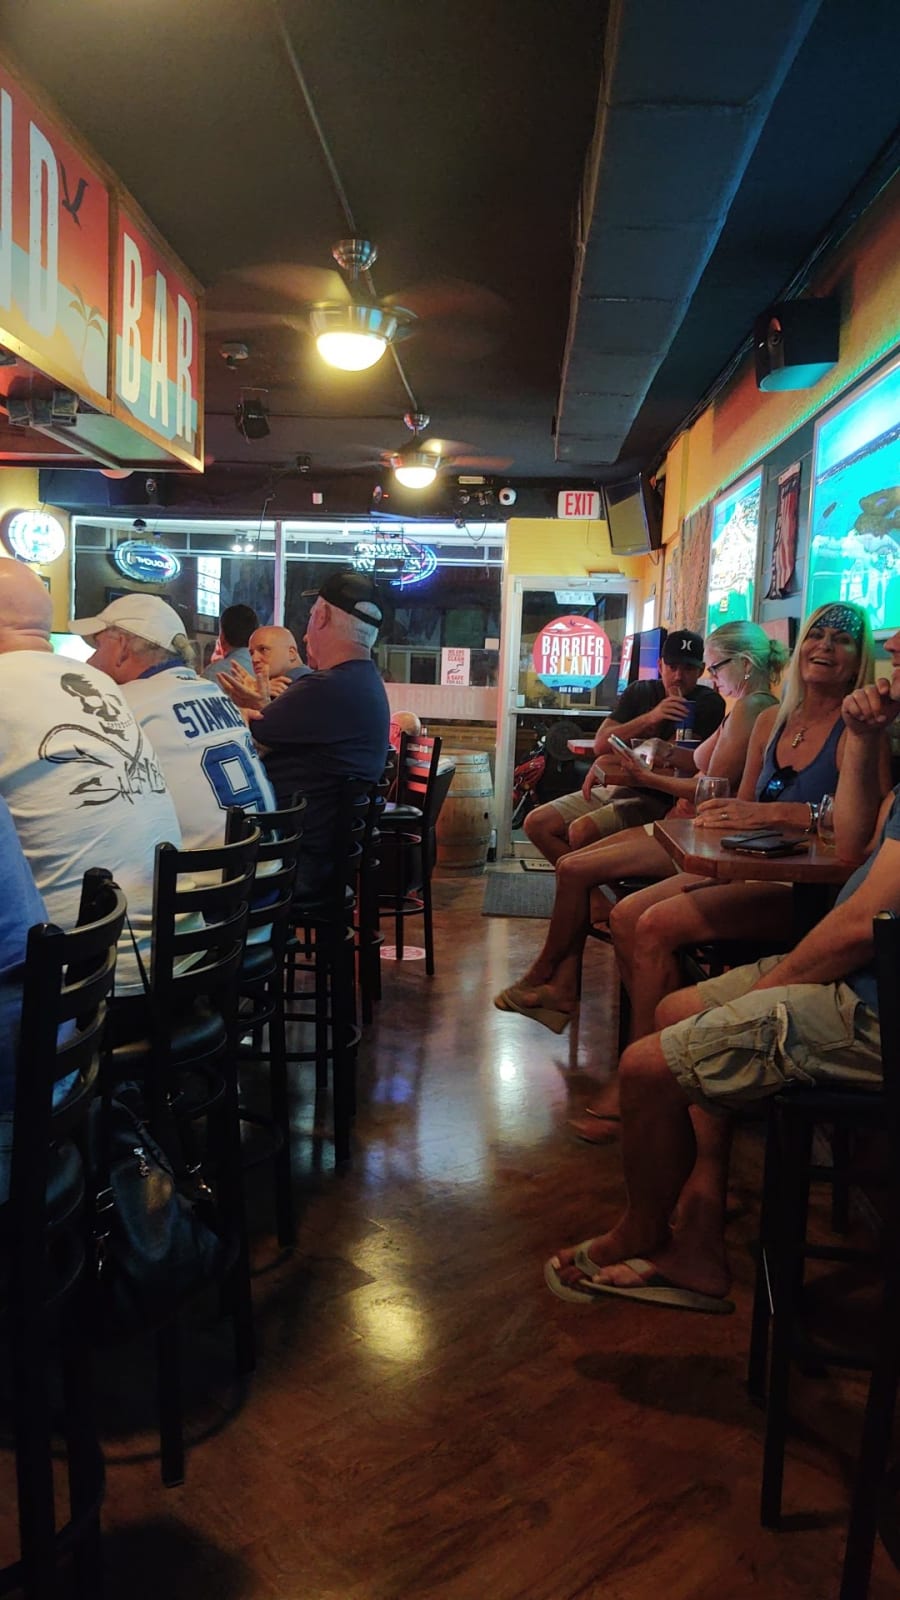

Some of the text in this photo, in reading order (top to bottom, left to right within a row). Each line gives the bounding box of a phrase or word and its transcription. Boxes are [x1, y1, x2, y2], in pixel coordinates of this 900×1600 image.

[121, 231, 193, 444] BAR
[565, 493, 594, 515] EXIT
[542, 635, 604, 657] BARRIER
[542, 655, 604, 675] ISLAND
[173, 696, 246, 739] STAMKO
